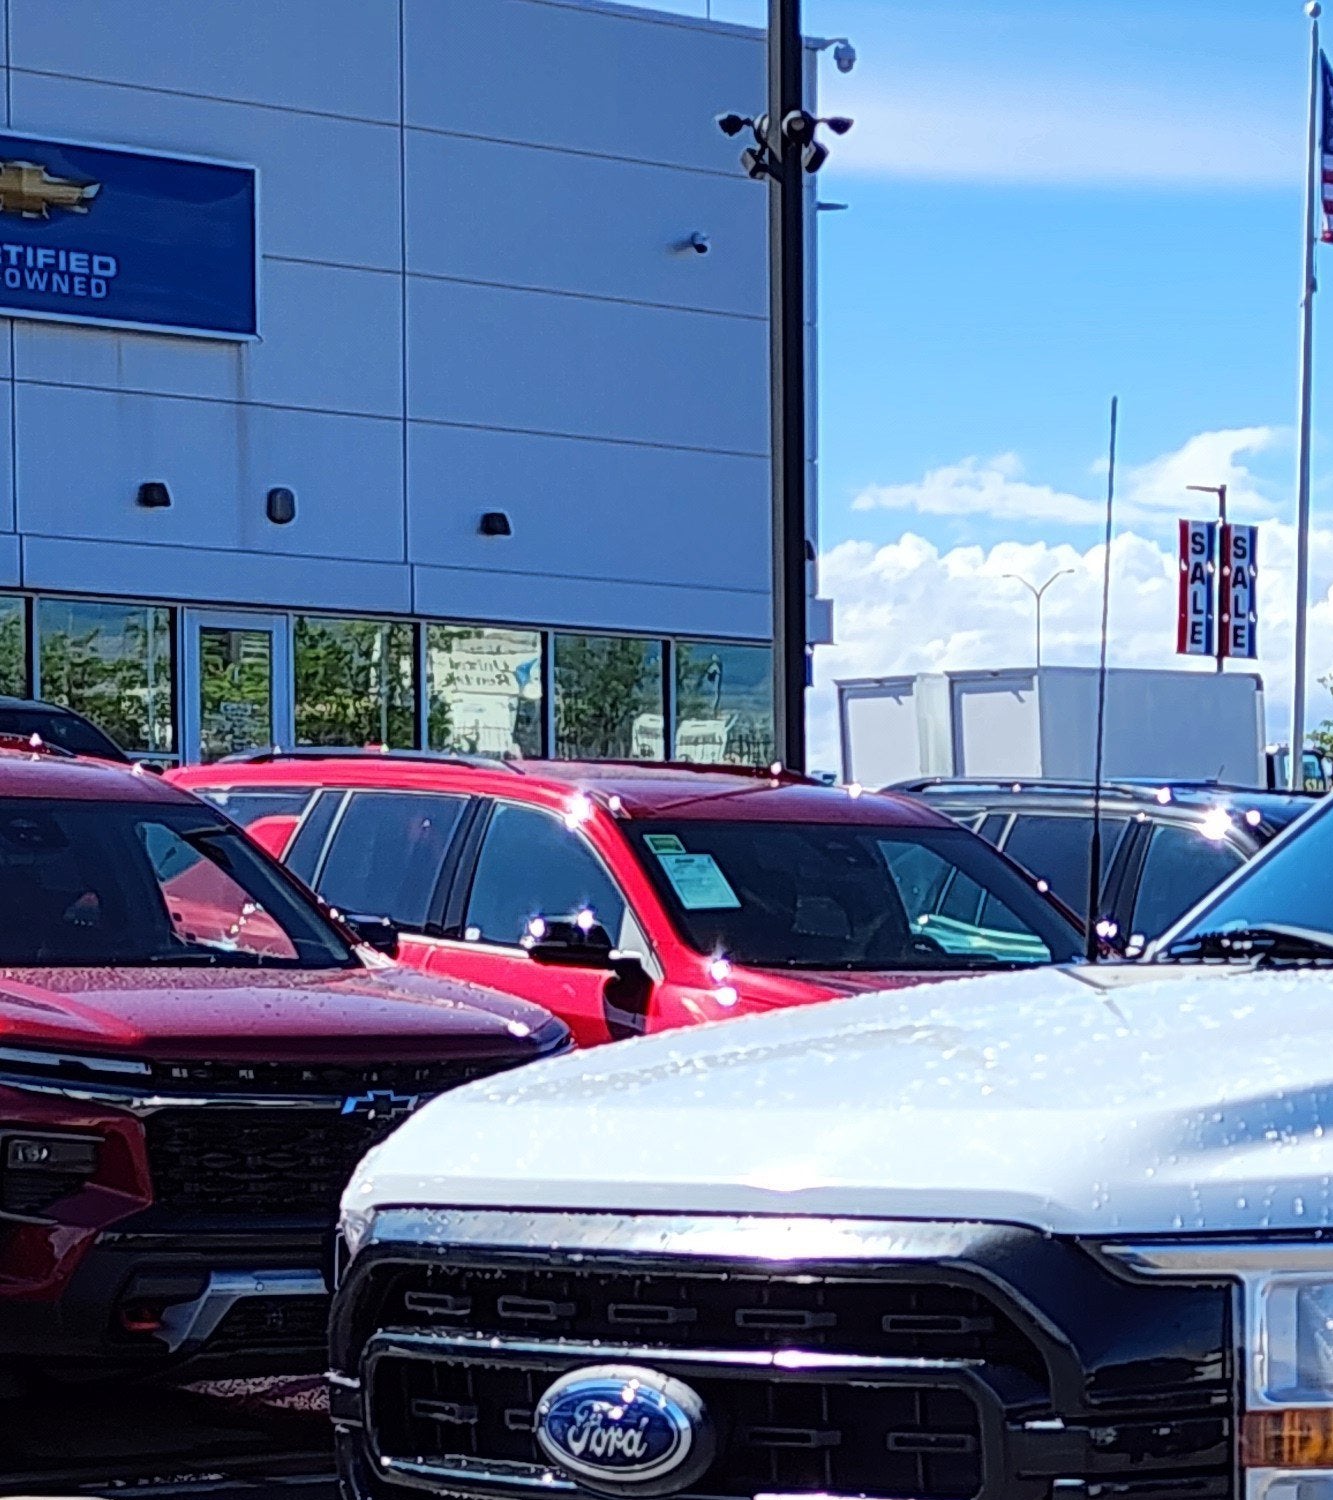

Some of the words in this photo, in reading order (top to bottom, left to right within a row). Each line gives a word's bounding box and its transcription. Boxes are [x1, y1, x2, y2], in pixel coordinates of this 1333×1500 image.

[0, 244, 118, 278] TIFIED
[3, 267, 108, 299] OWNED
[1190, 531, 1206, 645] SALE
[1231, 535, 1248, 649] SALE
[566, 1399, 650, 1458] Ford
